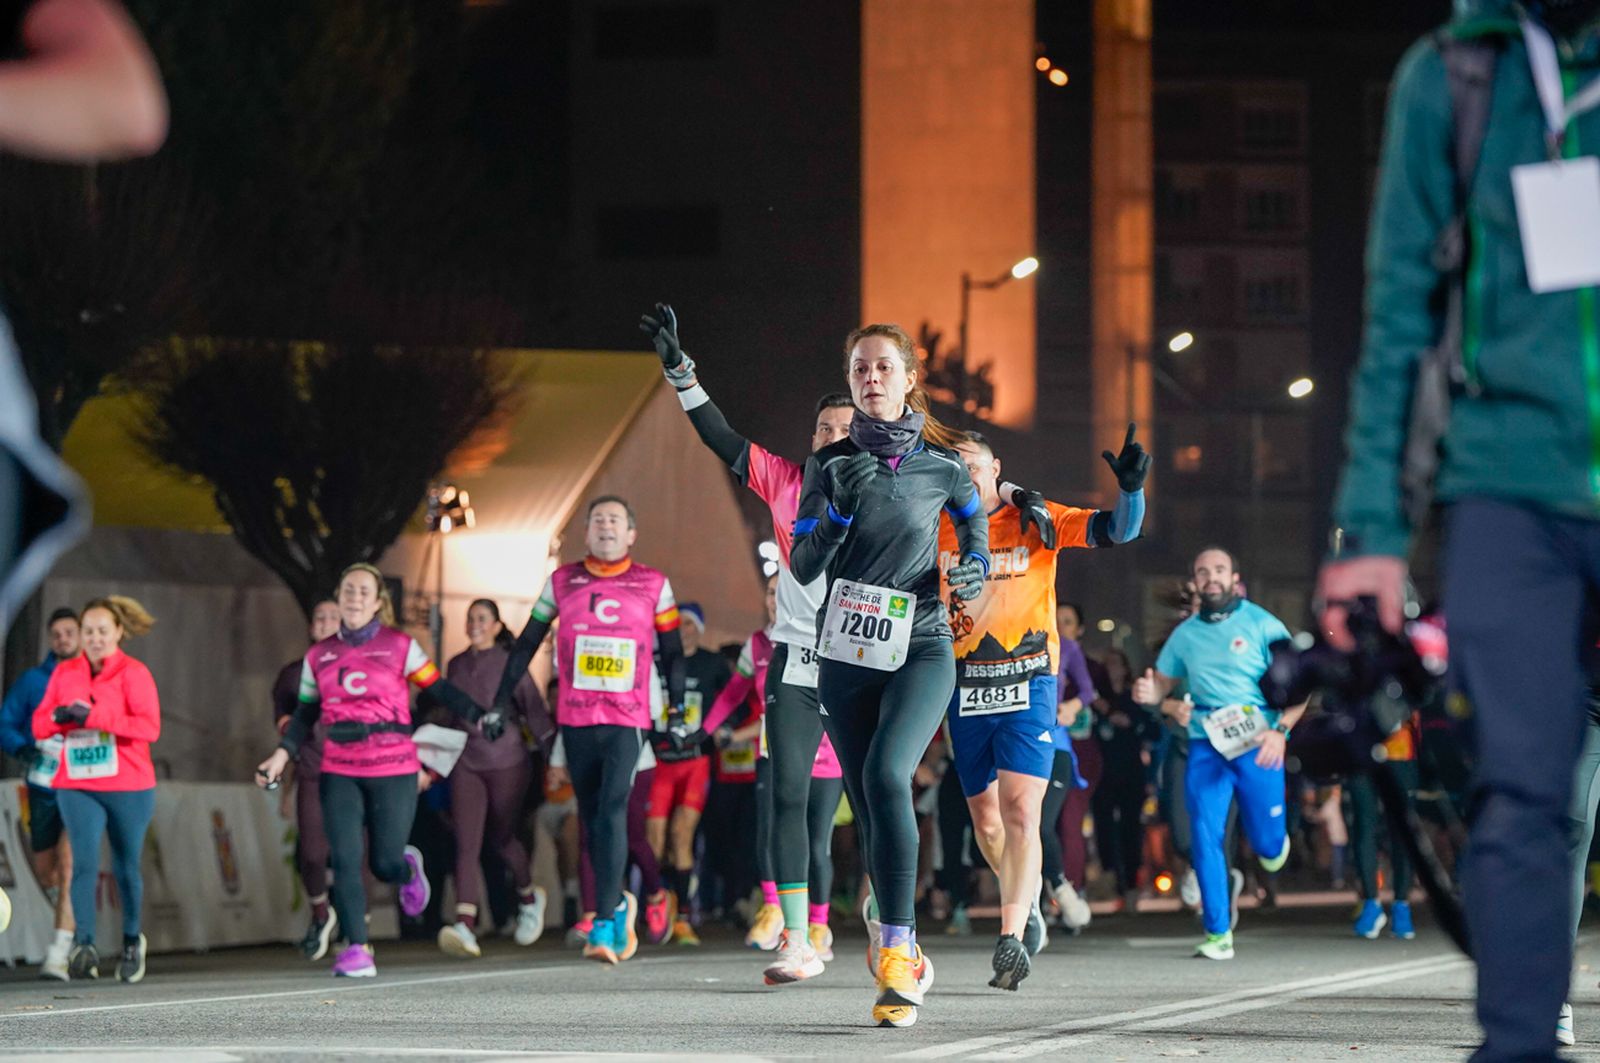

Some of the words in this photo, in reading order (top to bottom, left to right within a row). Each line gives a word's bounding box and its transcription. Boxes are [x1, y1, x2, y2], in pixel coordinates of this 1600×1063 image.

[840, 611, 893, 642] 1200
[586, 656, 624, 673] 8029
[801, 647, 819, 665] 34
[966, 685, 1020, 705] 4681
